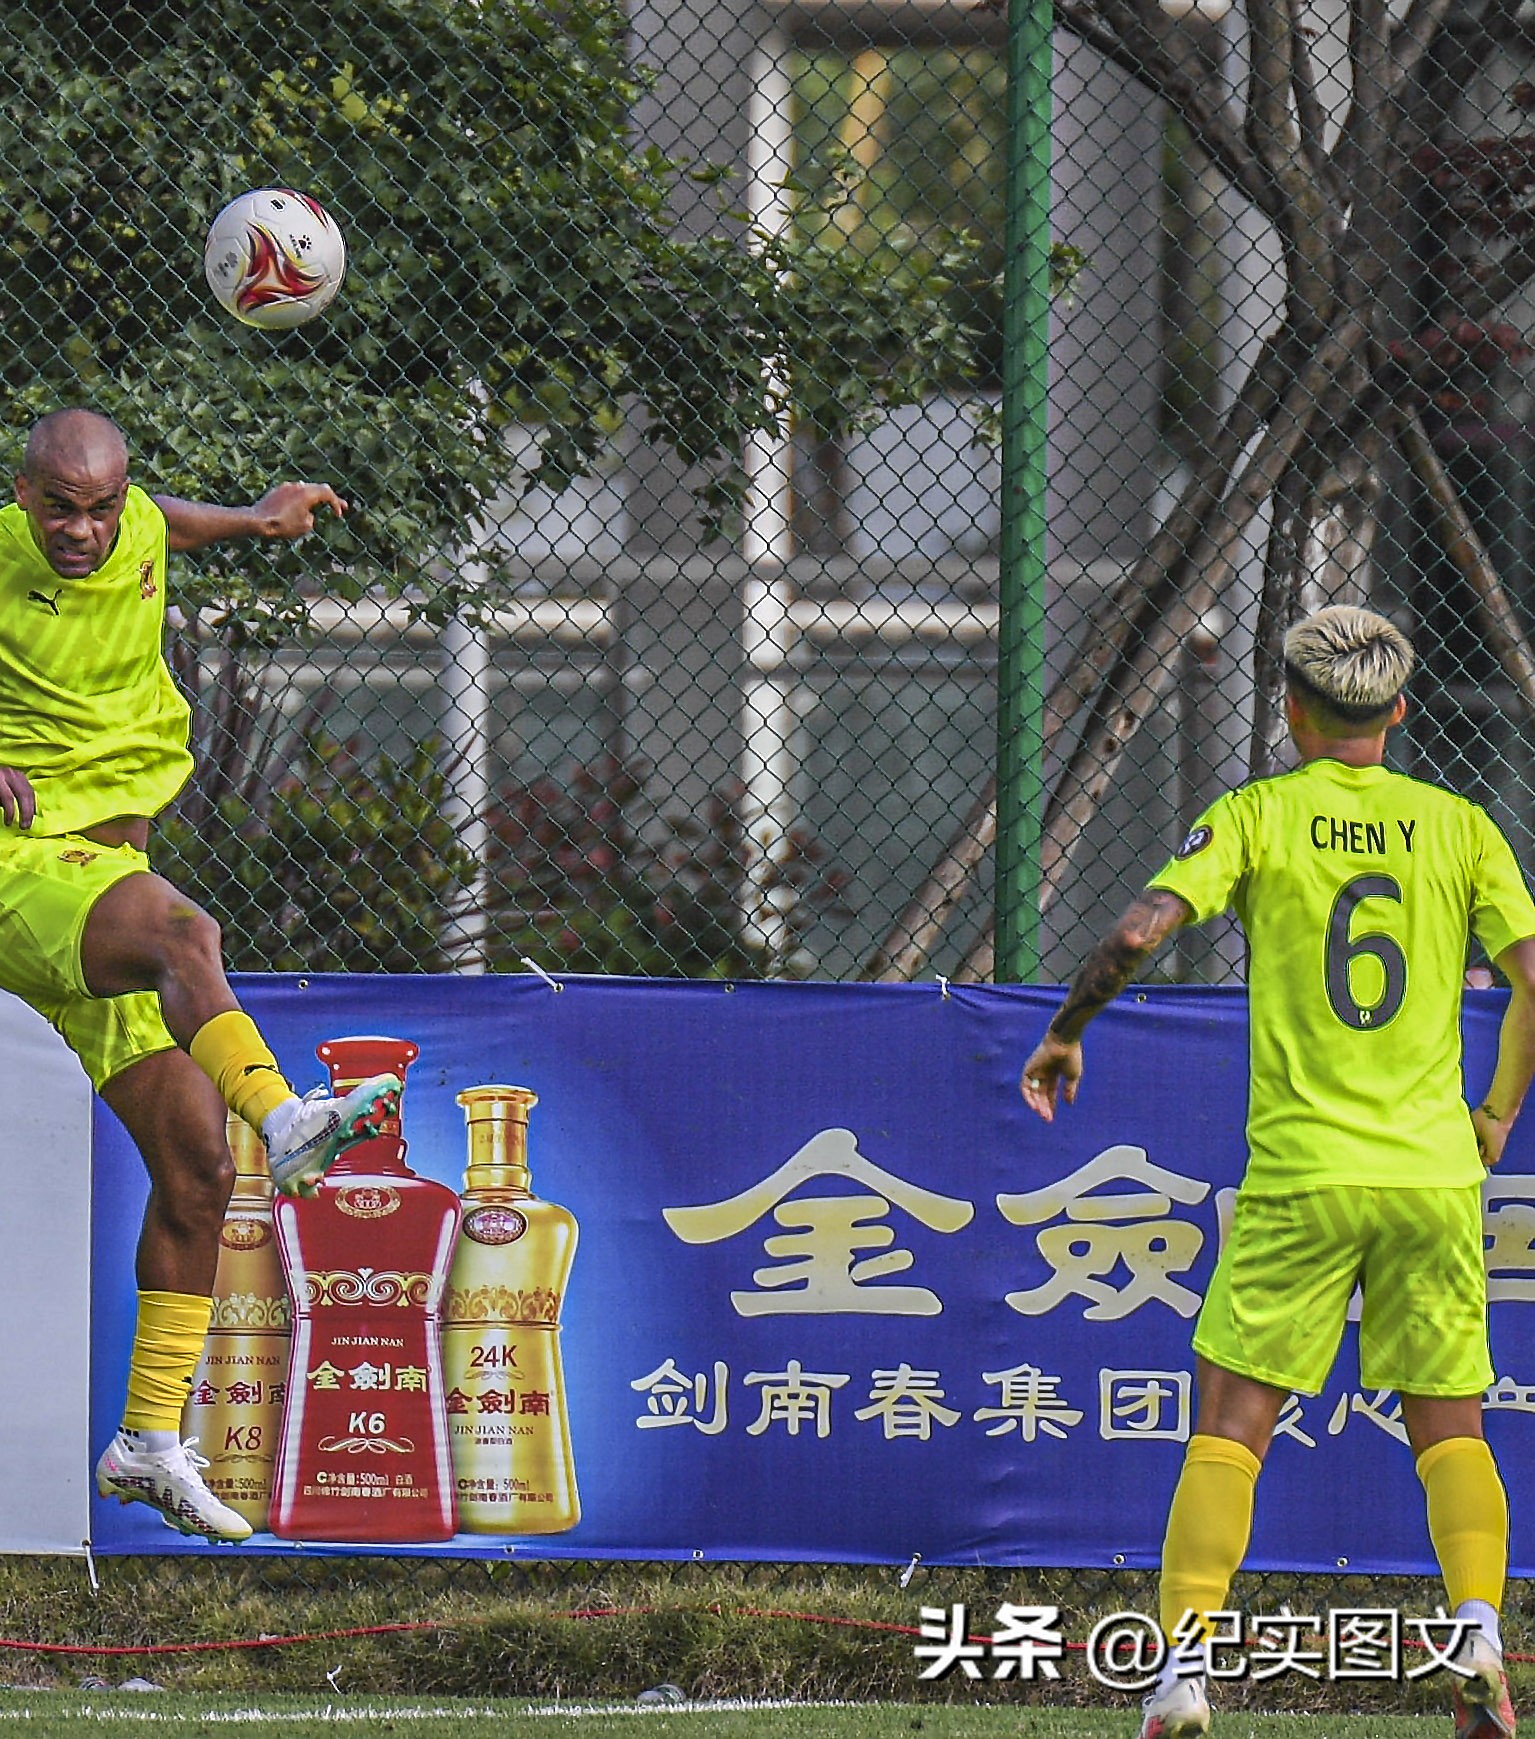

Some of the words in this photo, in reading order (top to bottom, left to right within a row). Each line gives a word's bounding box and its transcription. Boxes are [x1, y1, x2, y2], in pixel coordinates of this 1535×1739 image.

[1311, 815, 1386, 855] CHEN
[1397, 819, 1416, 853] Y
[1323, 871, 1409, 1031] 6
[331, 1336, 350, 1346] JIN
[351, 1336, 379, 1347] JIAN
[381, 1338, 404, 1348] NAN
[205, 1355, 223, 1366] JIN
[225, 1355, 254, 1366] JIAN
[256, 1355, 281, 1366] NAN
[470, 1345, 518, 1368] 24K
[348, 1411, 386, 1434] K6
[454, 1425, 474, 1435] JIN
[475, 1425, 505, 1435] JIAN
[508, 1425, 534, 1435] NAN
[224, 1426, 263, 1451] K8
